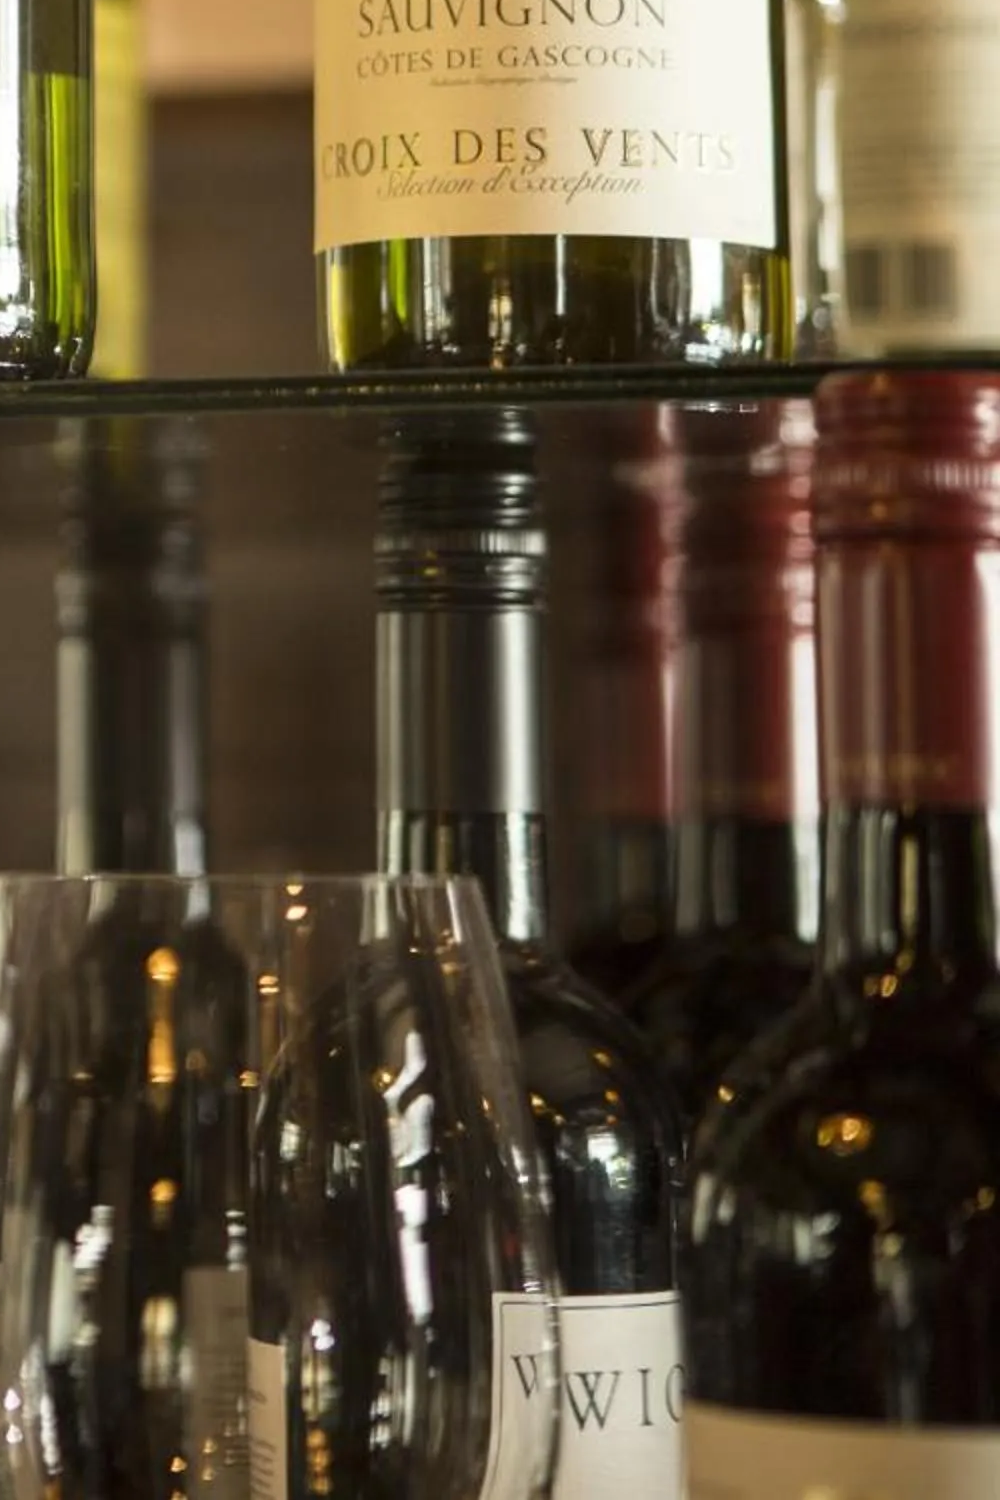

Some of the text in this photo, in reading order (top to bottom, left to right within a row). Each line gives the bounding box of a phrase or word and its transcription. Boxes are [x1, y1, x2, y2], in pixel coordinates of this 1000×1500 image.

[357, 45, 678, 79] CÔTES DE GASCOGNE
[321, 127, 736, 181] CROIX DES VENTS
